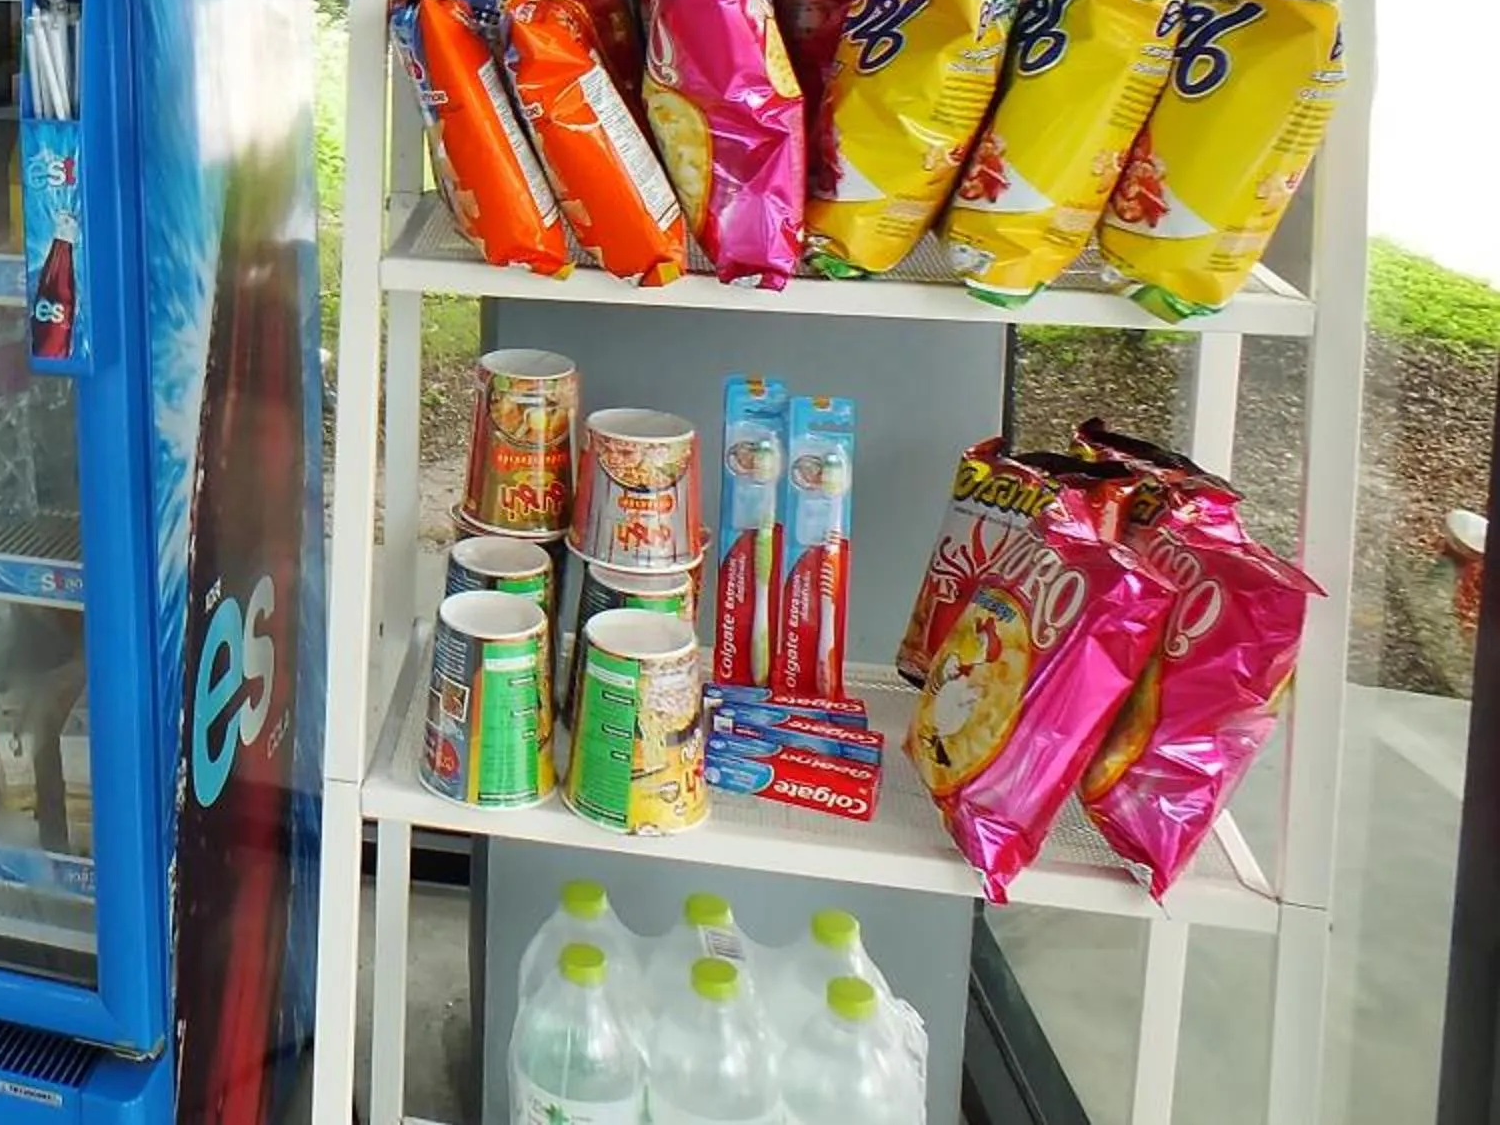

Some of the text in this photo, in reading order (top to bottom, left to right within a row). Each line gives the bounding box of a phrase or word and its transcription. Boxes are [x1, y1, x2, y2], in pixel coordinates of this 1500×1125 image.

[719, 613, 737, 680] Colgate
[784, 631, 801, 688] olgate
[773, 779, 869, 815] Colgate
